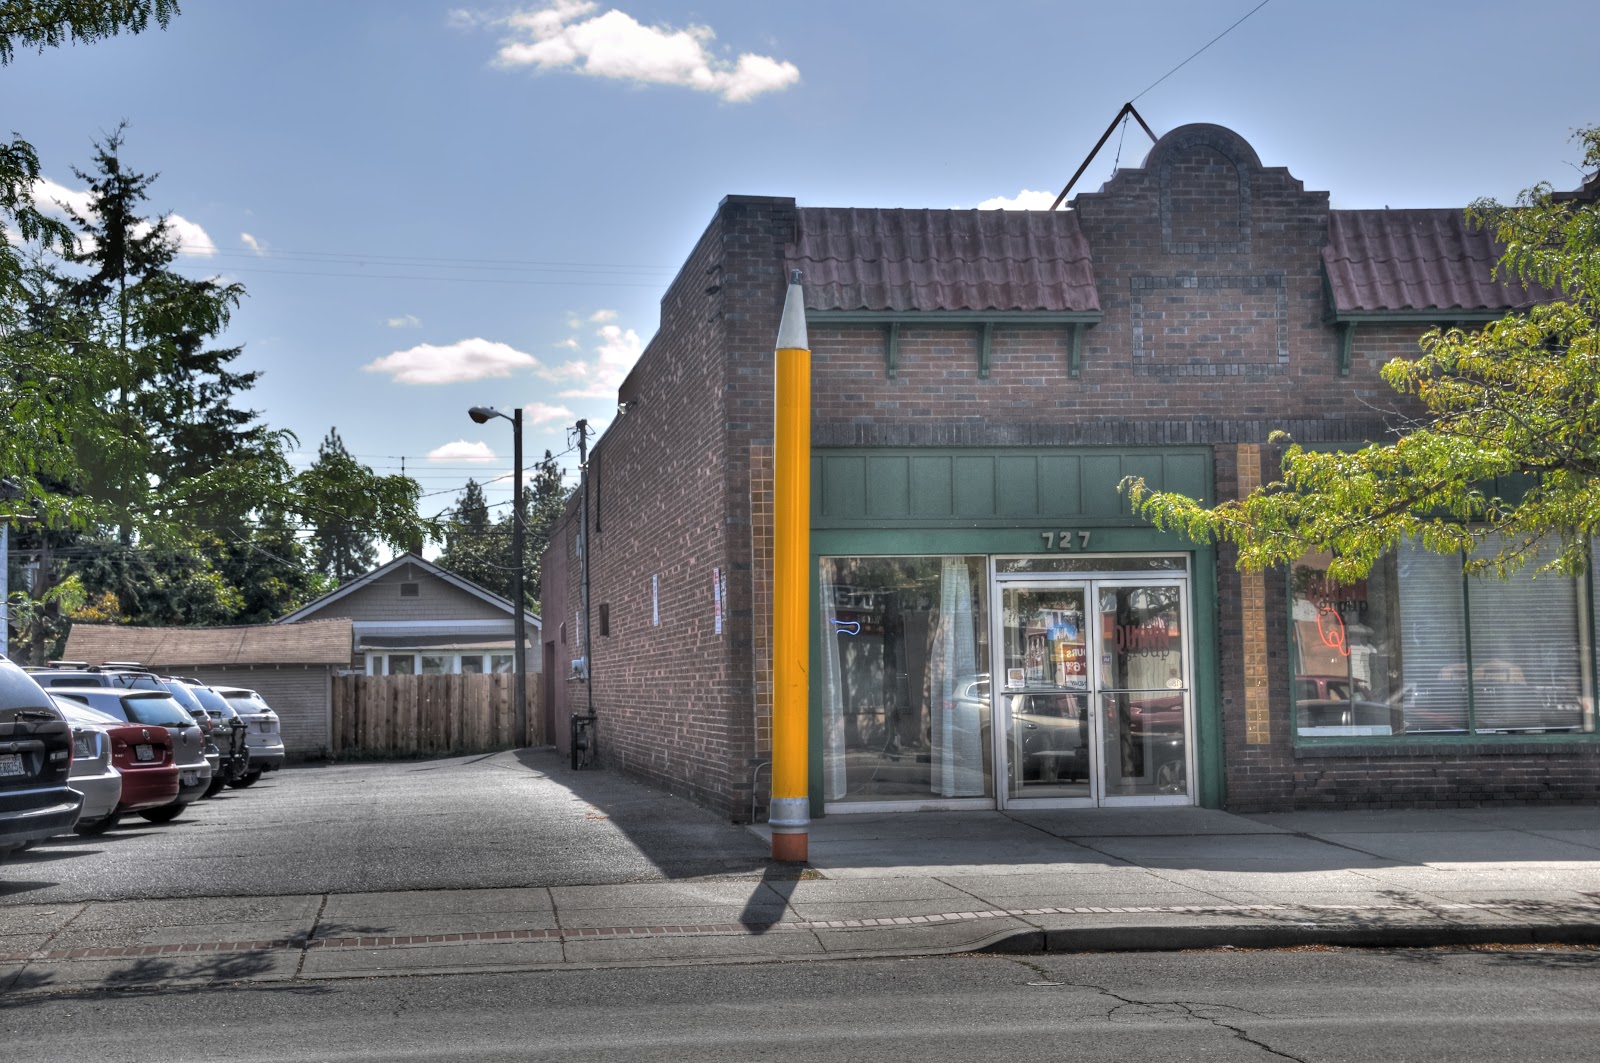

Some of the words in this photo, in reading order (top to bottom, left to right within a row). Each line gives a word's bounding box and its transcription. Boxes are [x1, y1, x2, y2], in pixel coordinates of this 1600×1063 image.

[1041, 531, 1091, 549] 727
[1319, 600, 1368, 616] group
[1113, 625, 1169, 655] QUINN
[1317, 607, 1352, 657] Q
[1125, 646, 1170, 661] group
